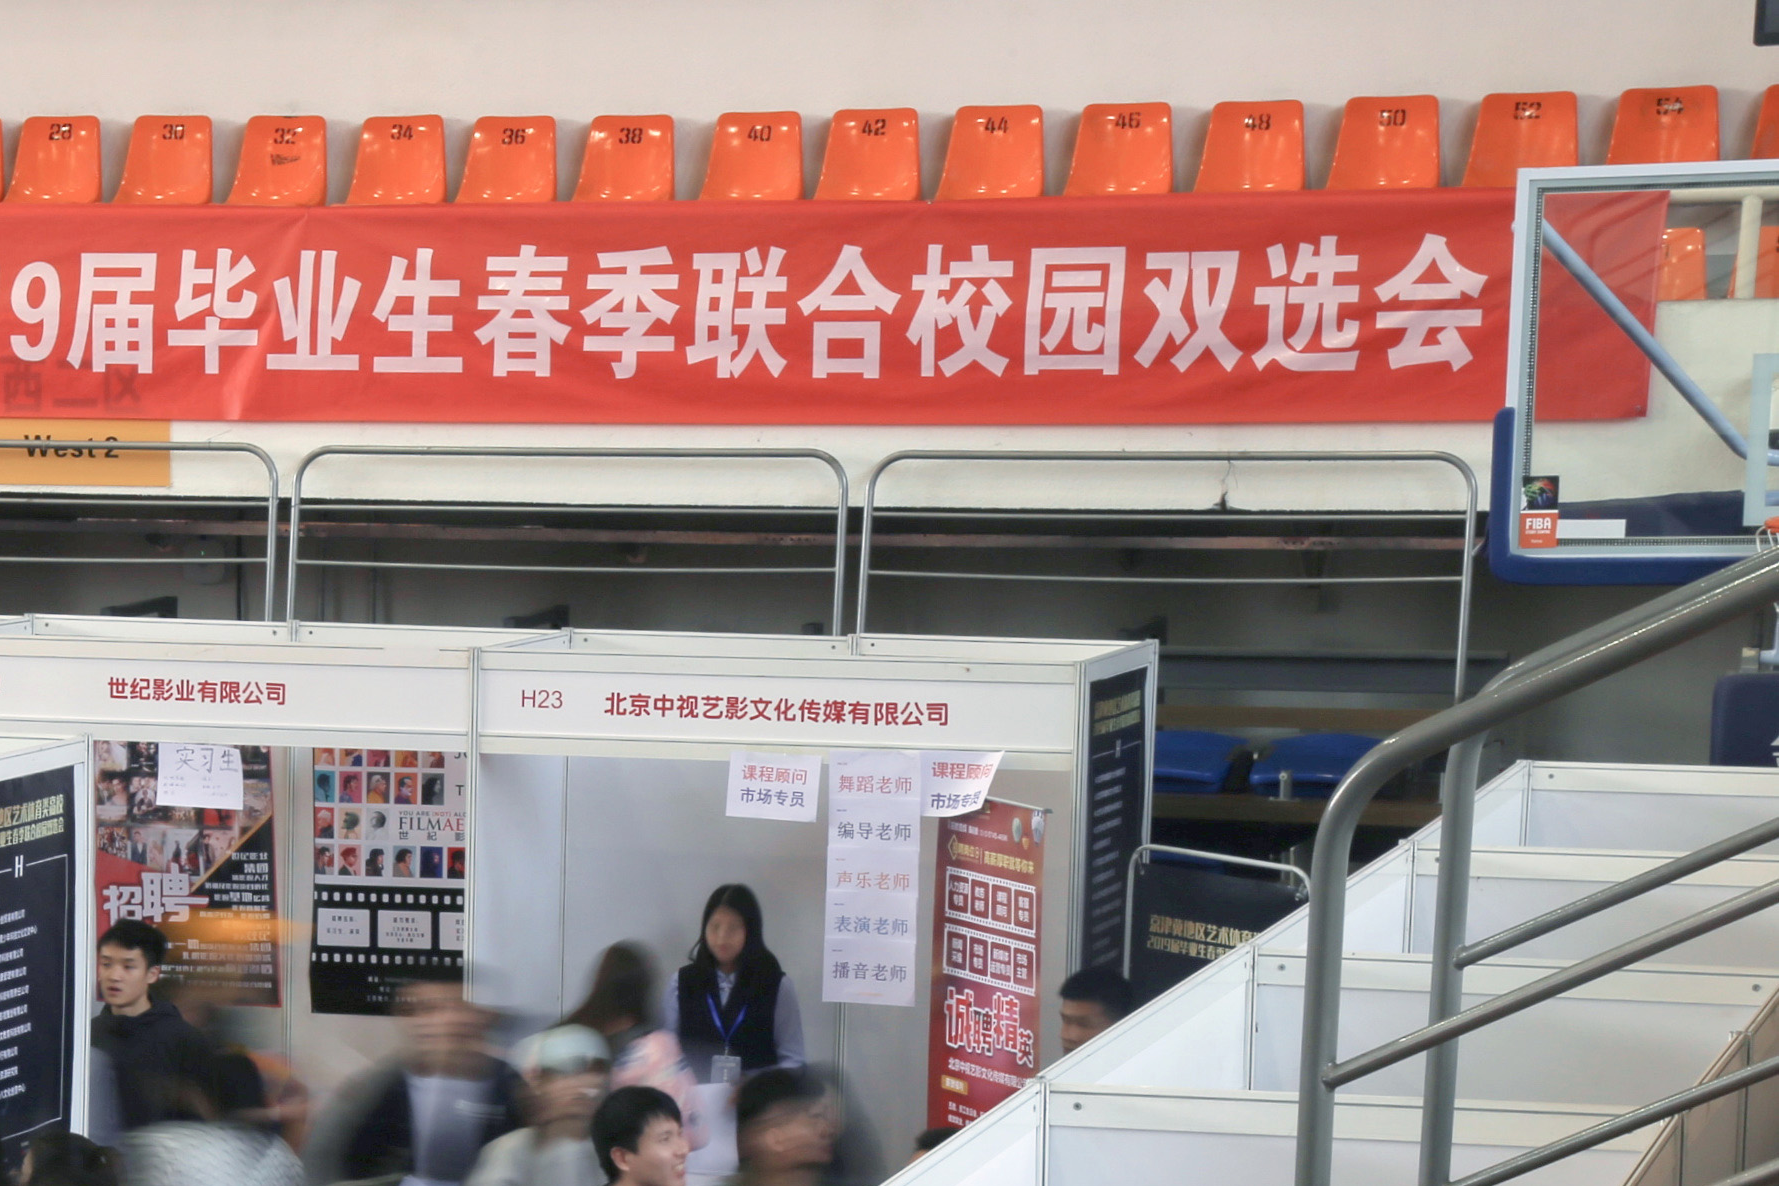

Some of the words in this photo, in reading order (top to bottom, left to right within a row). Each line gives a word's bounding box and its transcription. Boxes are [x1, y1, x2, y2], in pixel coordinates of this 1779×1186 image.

[862, 118, 887, 137] 42
[983, 116, 1009, 134] 44
[1244, 112, 1271, 131] 48
[1378, 108, 1407, 127] 50
[390, 124, 414, 142] 34
[501, 127, 526, 145] 36
[618, 127, 643, 145] 38
[747, 125, 772, 142] 40
[1525, 518, 1552, 530] FIBA
[107, 676, 287, 707] 世纪影业有限公司
[520, 689, 564, 710] H23
[603, 691, 951, 728] 北京中视艺影文化传媒有限公司
[741, 764, 808, 786] 课程顾问
[931, 761, 993, 780] 课程顾问
[837, 774, 913, 795] 舞蹈老师
[740, 786, 805, 808] 市场专员
[930, 790, 979, 811] 市场专员
[837, 821, 912, 842] 编导老师
[14, 854, 25, 879] H
[835, 870, 910, 892] 声乐老师
[102, 861, 210, 927] 招聘
[834, 915, 909, 937] 表演老师
[1149, 913, 1261, 947] 京津冀地区艺术体育
[832, 960, 907, 983] 播音老师
[944, 986, 1034, 1069] 诚聘精英
